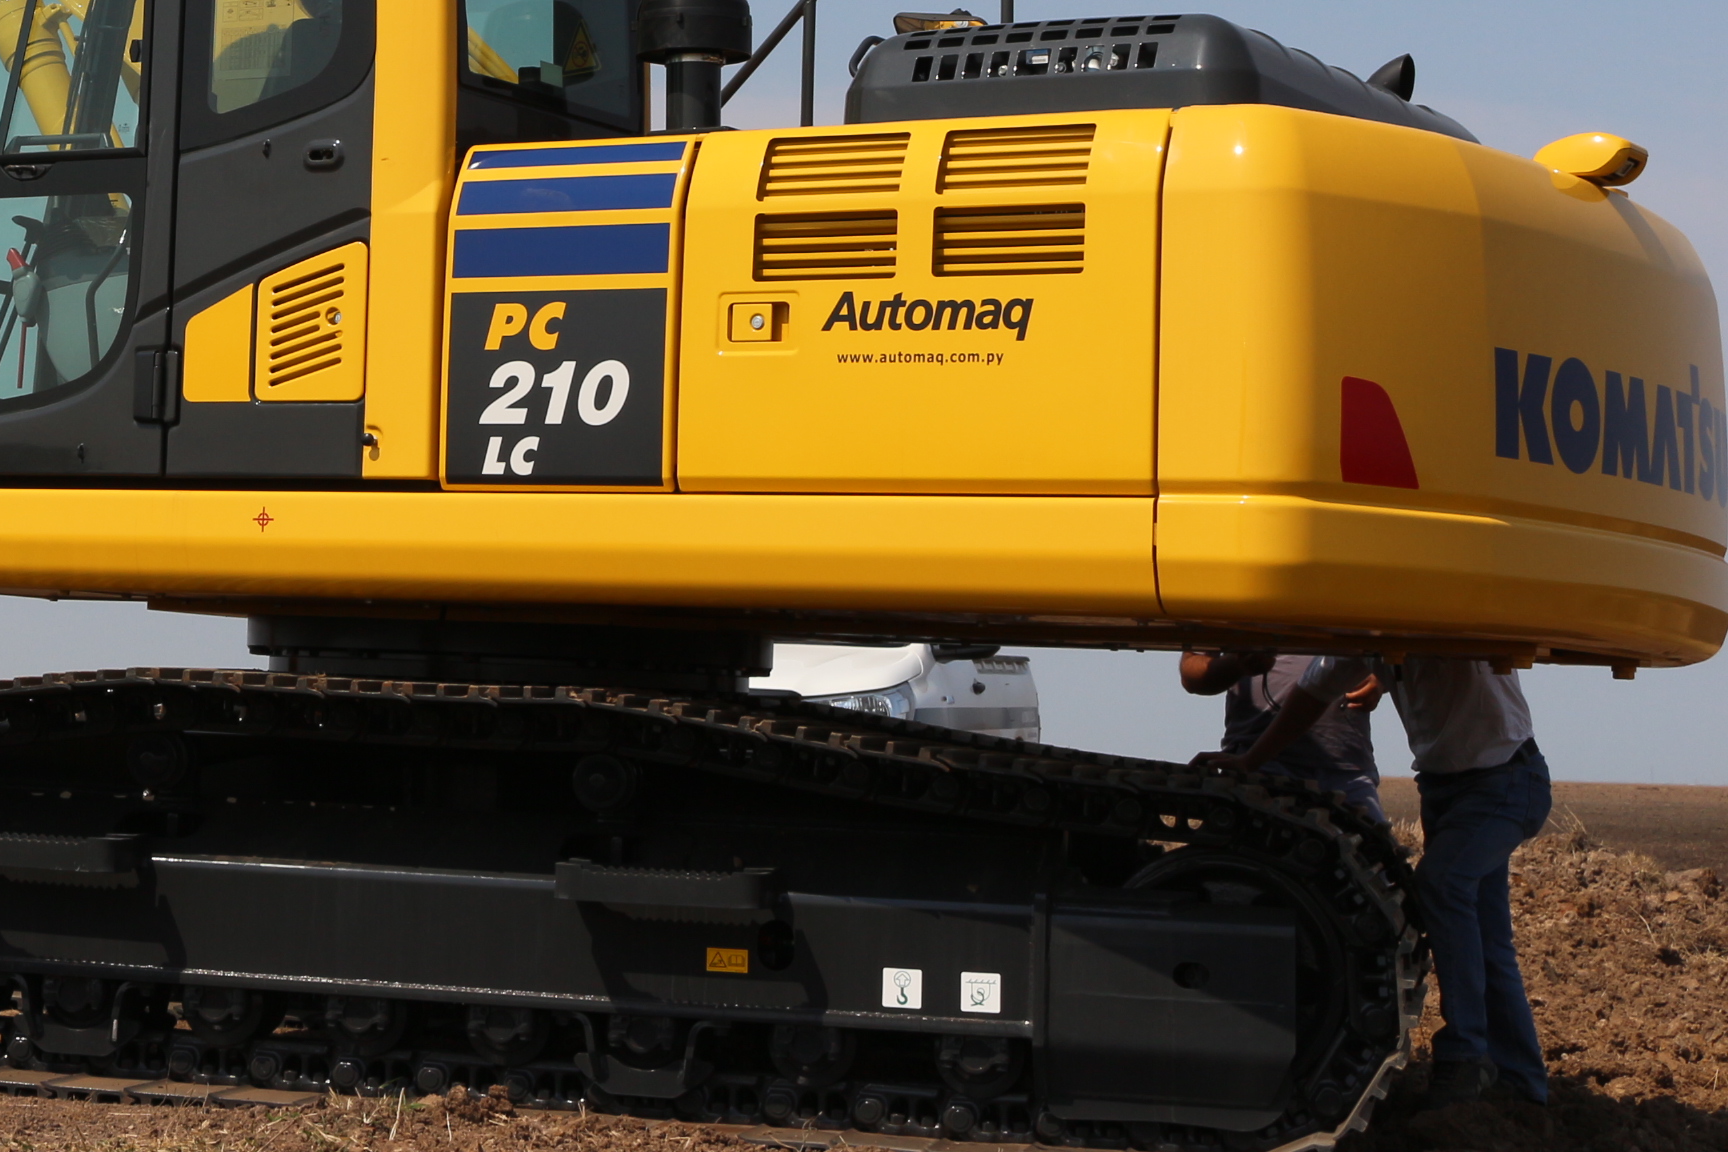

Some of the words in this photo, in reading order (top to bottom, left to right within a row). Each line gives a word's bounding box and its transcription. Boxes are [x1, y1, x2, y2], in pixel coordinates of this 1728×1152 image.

[484, 301, 567, 351] PC
[821, 291, 1034, 341] Automaq
[837, 351, 1004, 366] www.automaq.com.py
[478, 359, 630, 426] 210
[1494, 346, 1728, 509] KOMATSU
[481, 436, 540, 476] LC
